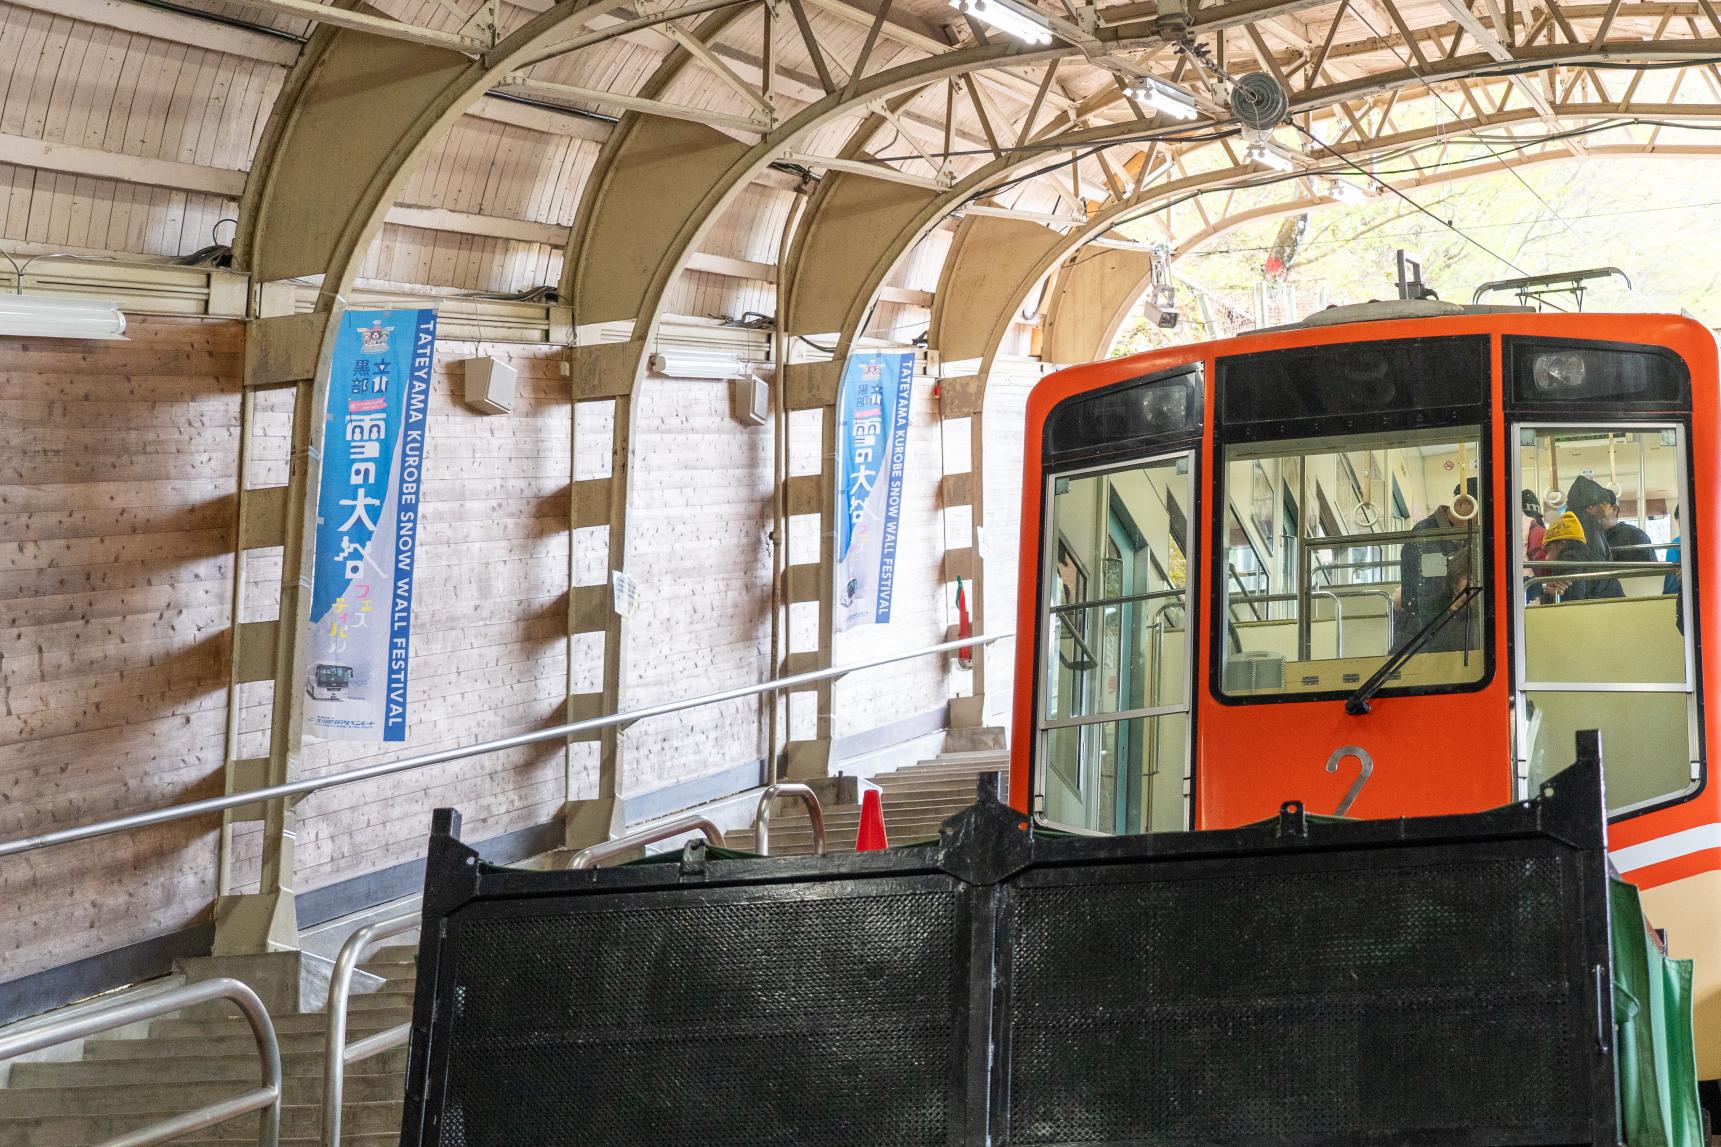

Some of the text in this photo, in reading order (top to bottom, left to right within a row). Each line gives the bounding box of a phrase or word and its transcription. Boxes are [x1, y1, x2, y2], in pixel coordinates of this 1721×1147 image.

[388, 319, 434, 727] TATEYAMA KUROBE SNOW WALL FESTIVAL
[878, 360, 913, 616] TATEYAMA KUROBE SNOW WALL FESTIVAL
[1326, 744, 1374, 817] 2
